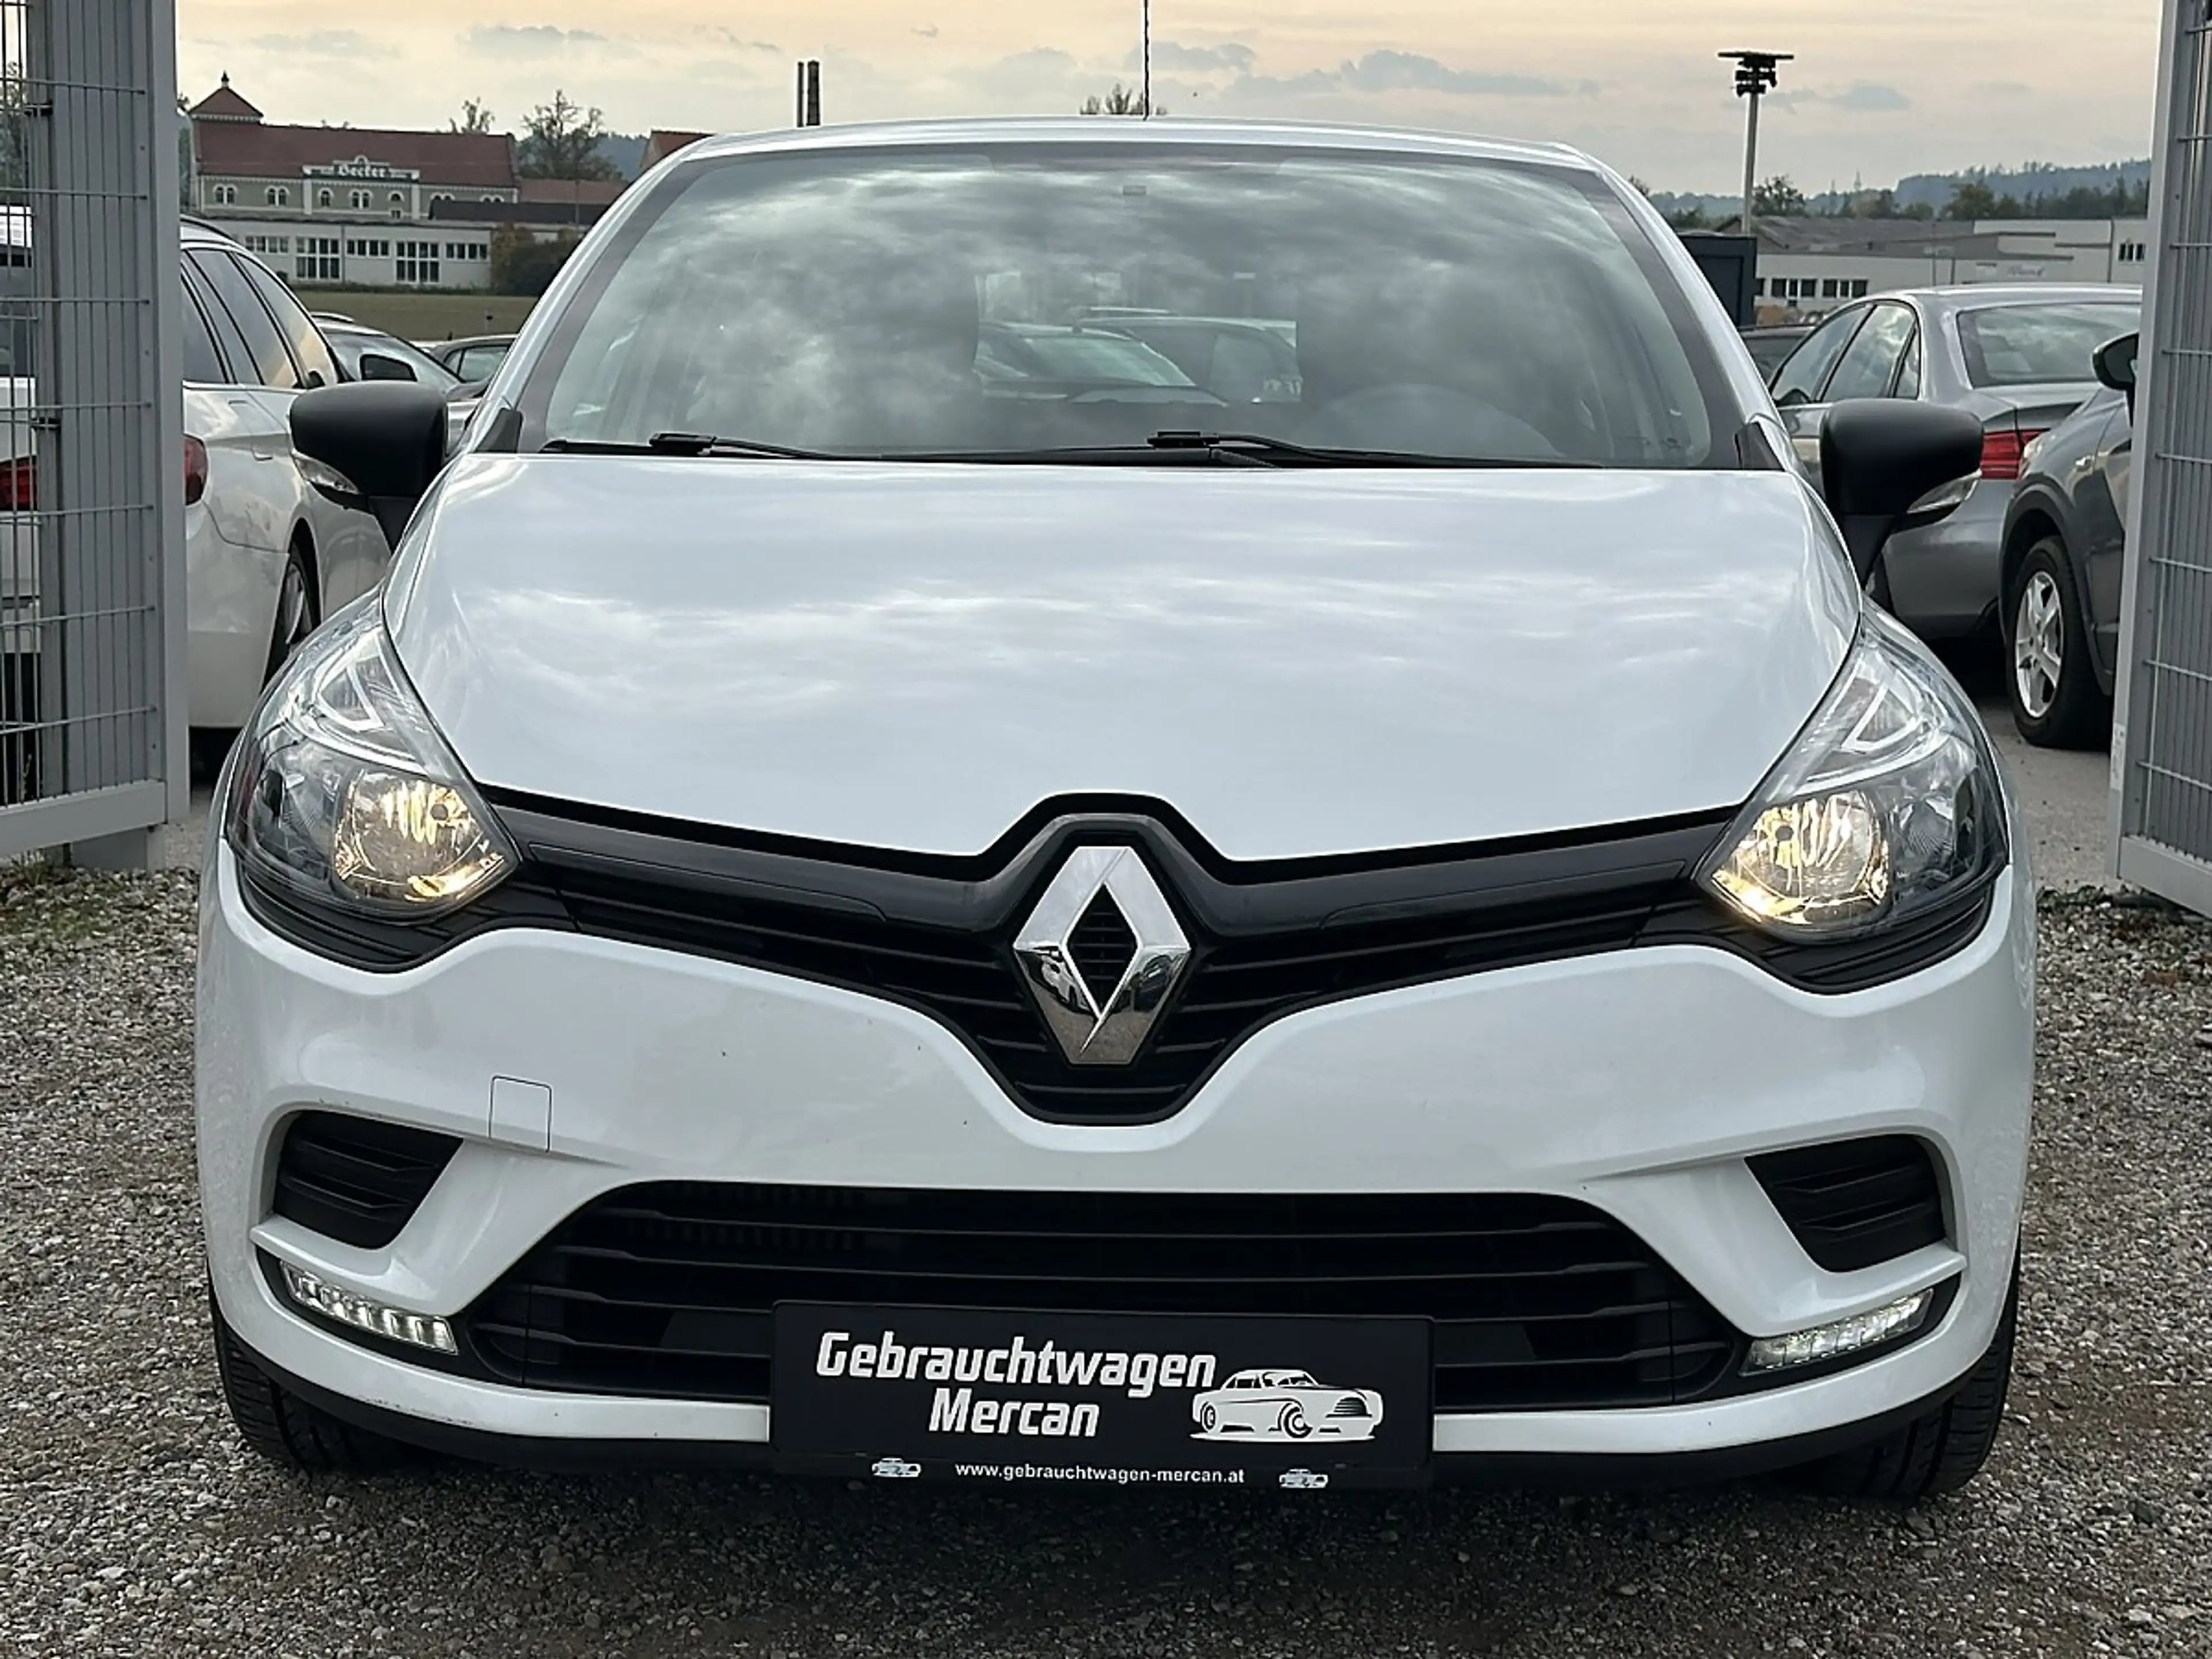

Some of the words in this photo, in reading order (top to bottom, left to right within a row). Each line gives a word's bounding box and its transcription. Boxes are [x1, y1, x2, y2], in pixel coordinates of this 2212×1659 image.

[816, 1331, 1217, 1398] Gebrauchtwagen
[929, 1388, 1100, 1438] Mercan
[955, 1463, 1245, 1484] www.gebrauchtwagen-mercan.at
